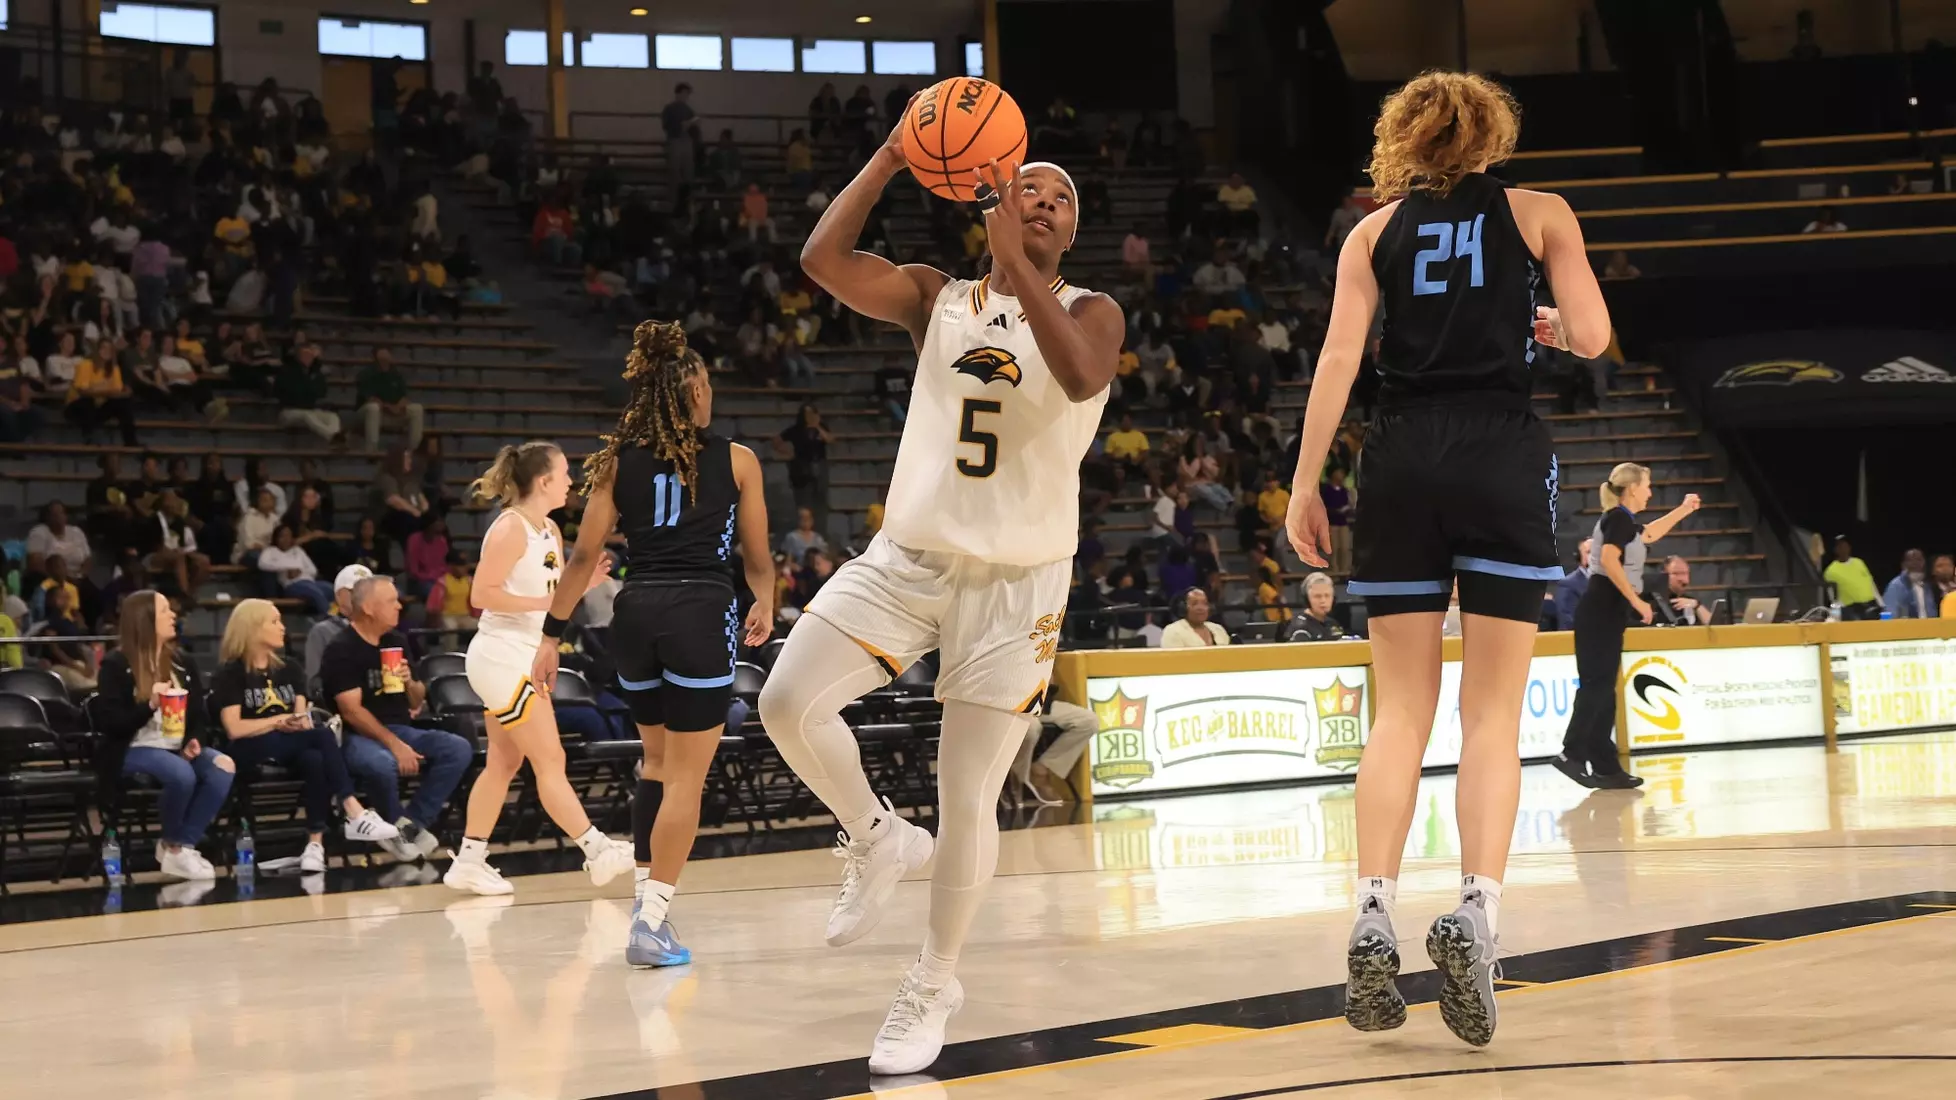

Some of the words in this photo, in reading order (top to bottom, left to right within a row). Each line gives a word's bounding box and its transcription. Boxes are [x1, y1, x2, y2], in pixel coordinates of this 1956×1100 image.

[1413, 213, 1485, 296] 24
[955, 397, 1002, 480] 5
[653, 473, 682, 527] 11
[1166, 713, 1202, 749] KEG
[1227, 710, 1298, 740] BARREL
[1858, 690, 1932, 727] GAMEDAY
